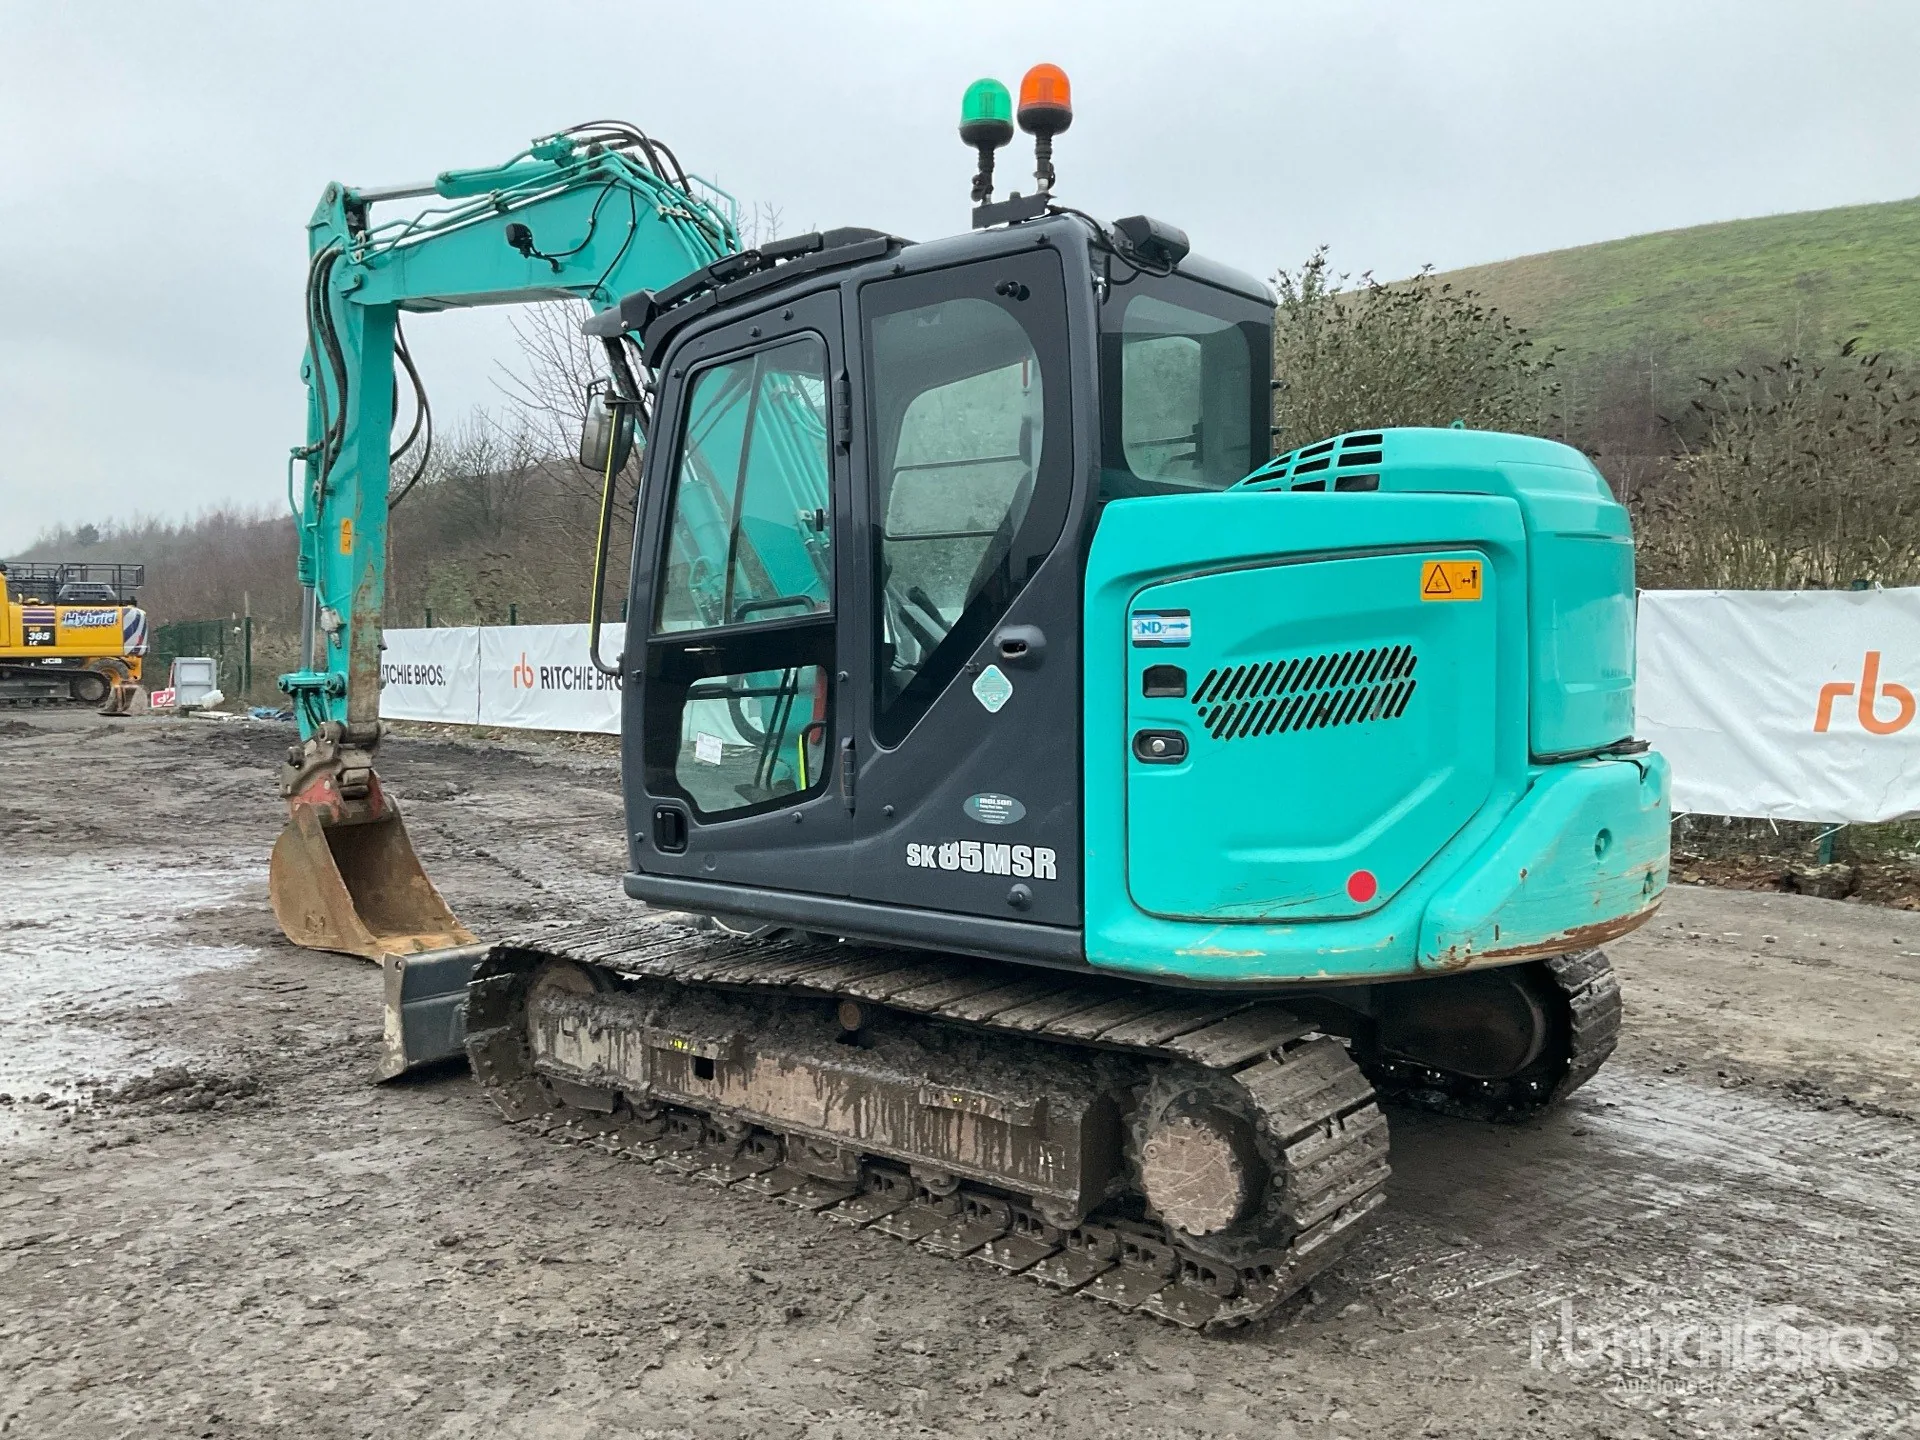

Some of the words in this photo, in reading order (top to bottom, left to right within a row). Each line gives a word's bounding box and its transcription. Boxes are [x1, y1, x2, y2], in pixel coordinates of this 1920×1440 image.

[64, 612, 118, 626] Hybrid
[28, 632, 50, 641] 365
[414, 664, 446, 686] BROS.
[513, 652, 534, 688] rb
[540, 666, 593, 690] RITCHIE
[1813, 651, 1916, 735] rb
